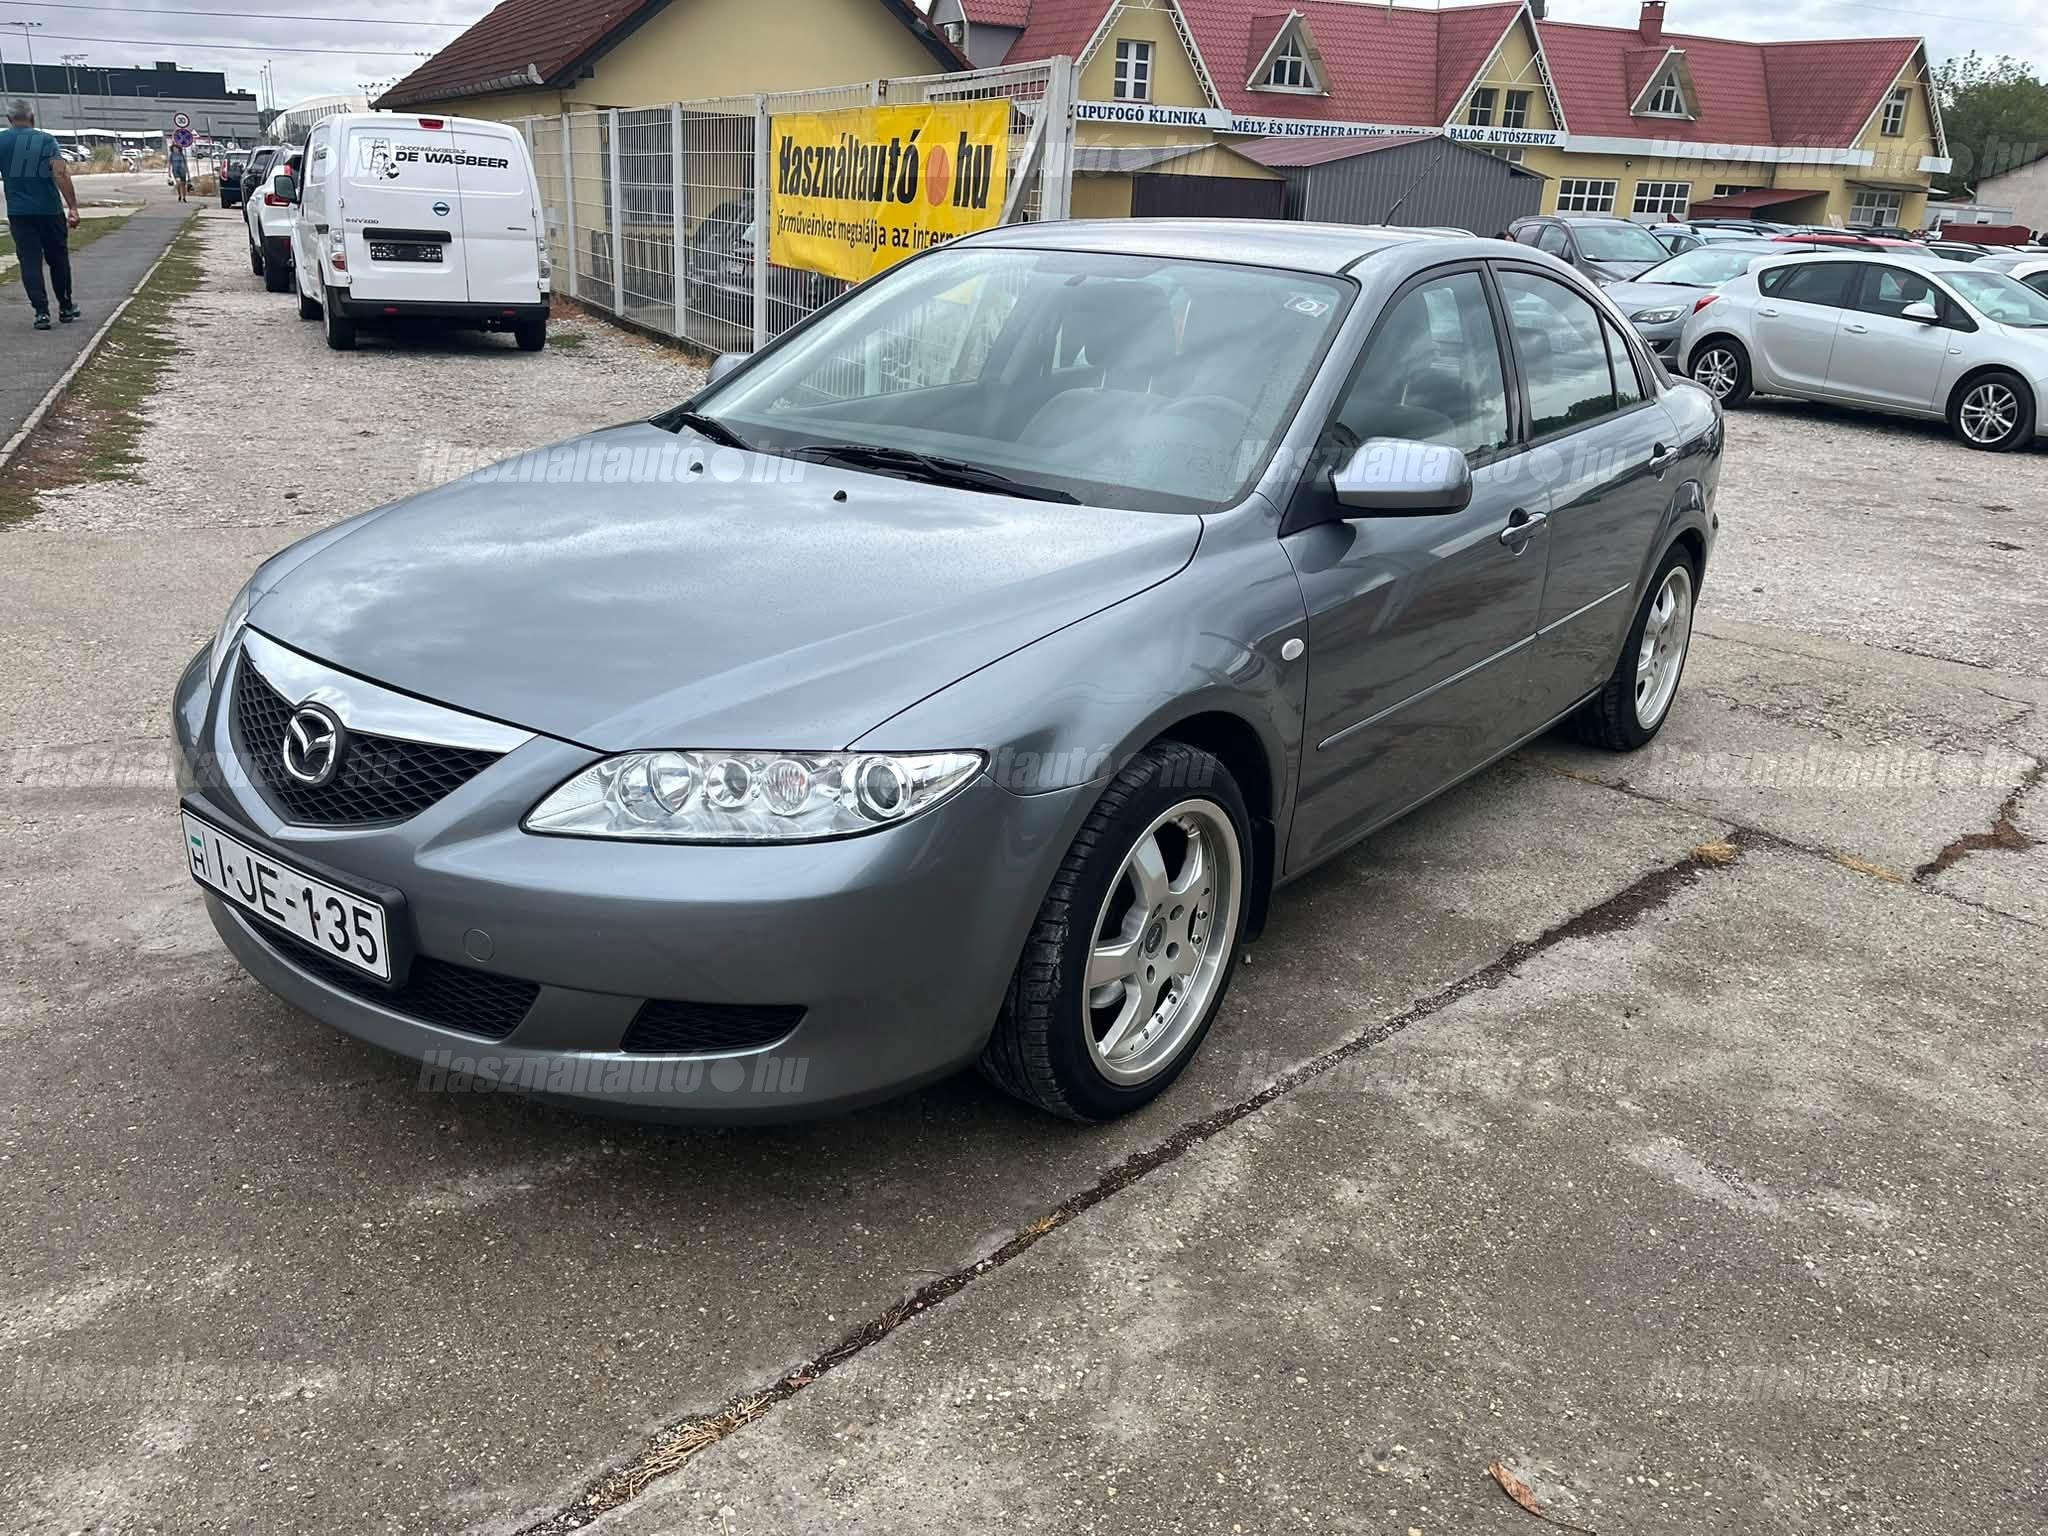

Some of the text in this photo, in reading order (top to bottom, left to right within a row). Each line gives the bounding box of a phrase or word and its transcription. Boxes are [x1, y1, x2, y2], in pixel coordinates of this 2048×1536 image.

[1149, 109, 1207, 125] KLINIKA
[1269, 119, 1283, 134] ÉS
[1450, 128, 1484, 141] BALOG
[1487, 129, 1557, 145] AUTÓSZERVIZ
[395, 151, 509, 169] DE WASBEER
[778, 129, 993, 209] Használtautó hu
[892, 226, 909, 249] az
[913, 223, 967, 249] intern
[191, 847, 207, 875] H
[215, 838, 378, 964] IJE-135
